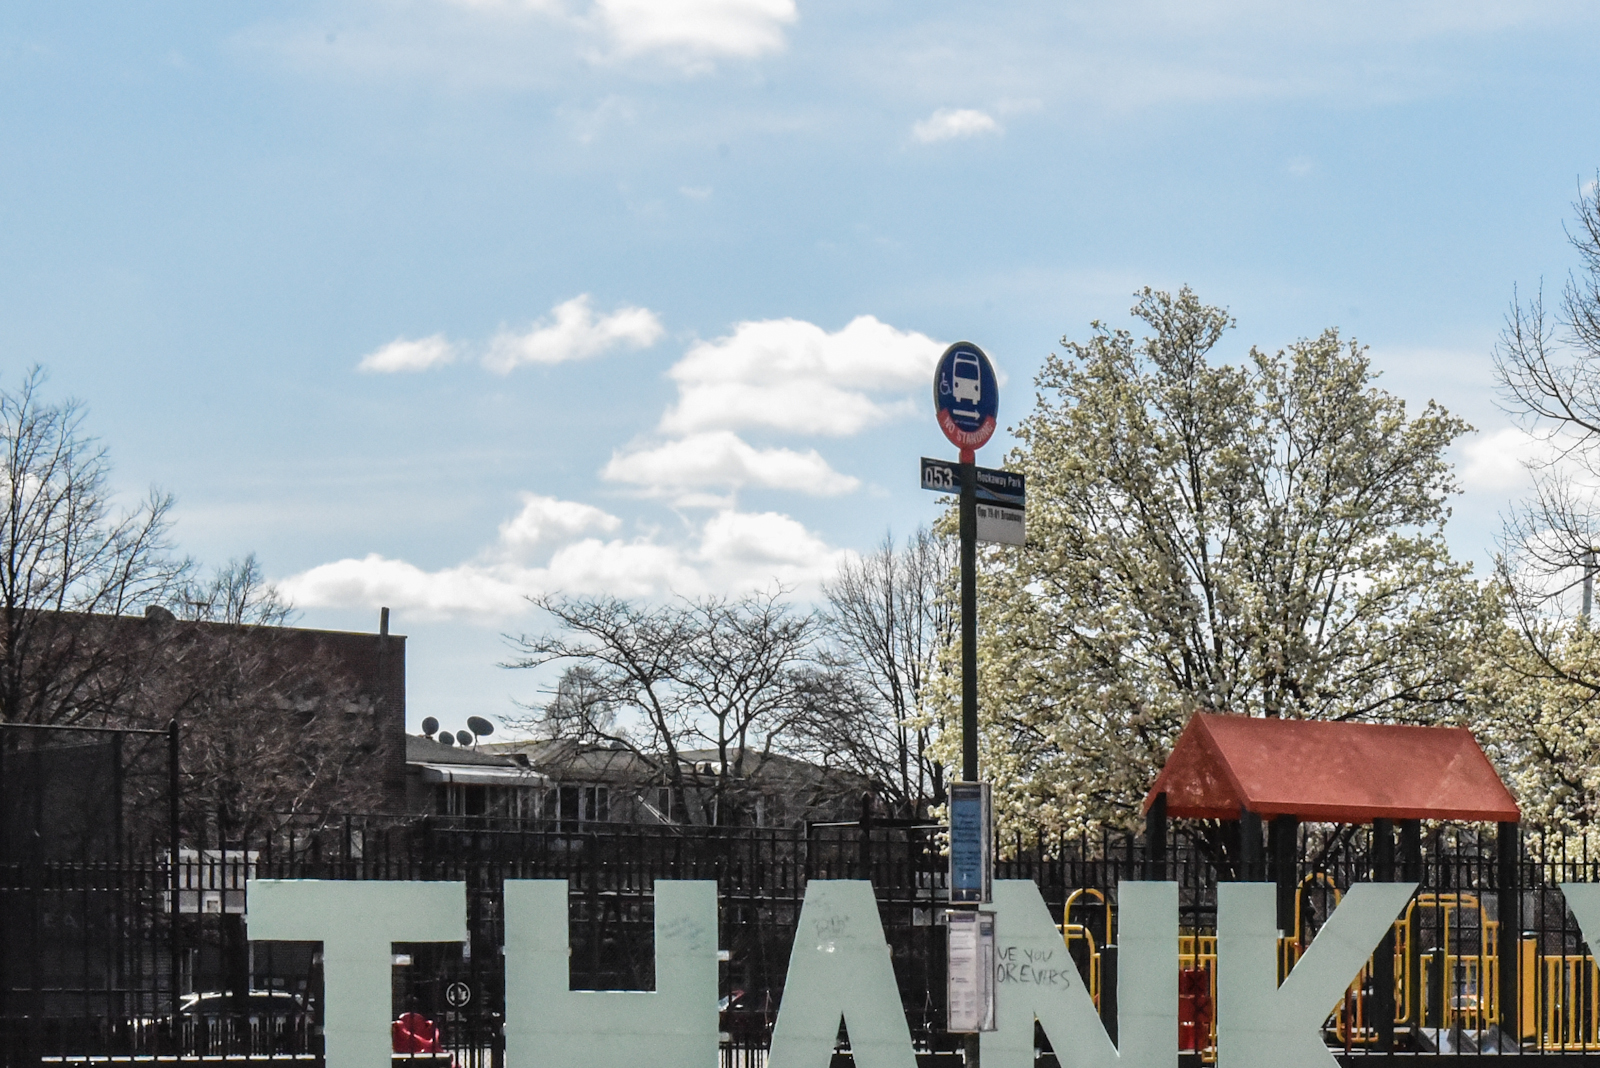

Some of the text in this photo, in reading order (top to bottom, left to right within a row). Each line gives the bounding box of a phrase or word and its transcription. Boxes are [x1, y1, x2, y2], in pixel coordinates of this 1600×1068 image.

[944, 416, 993, 444] NO STANDING
[977, 471, 1021, 488] Rockaway Park
[1024, 949, 1053, 963] YOU
[996, 962, 1070, 991] OREVERS
